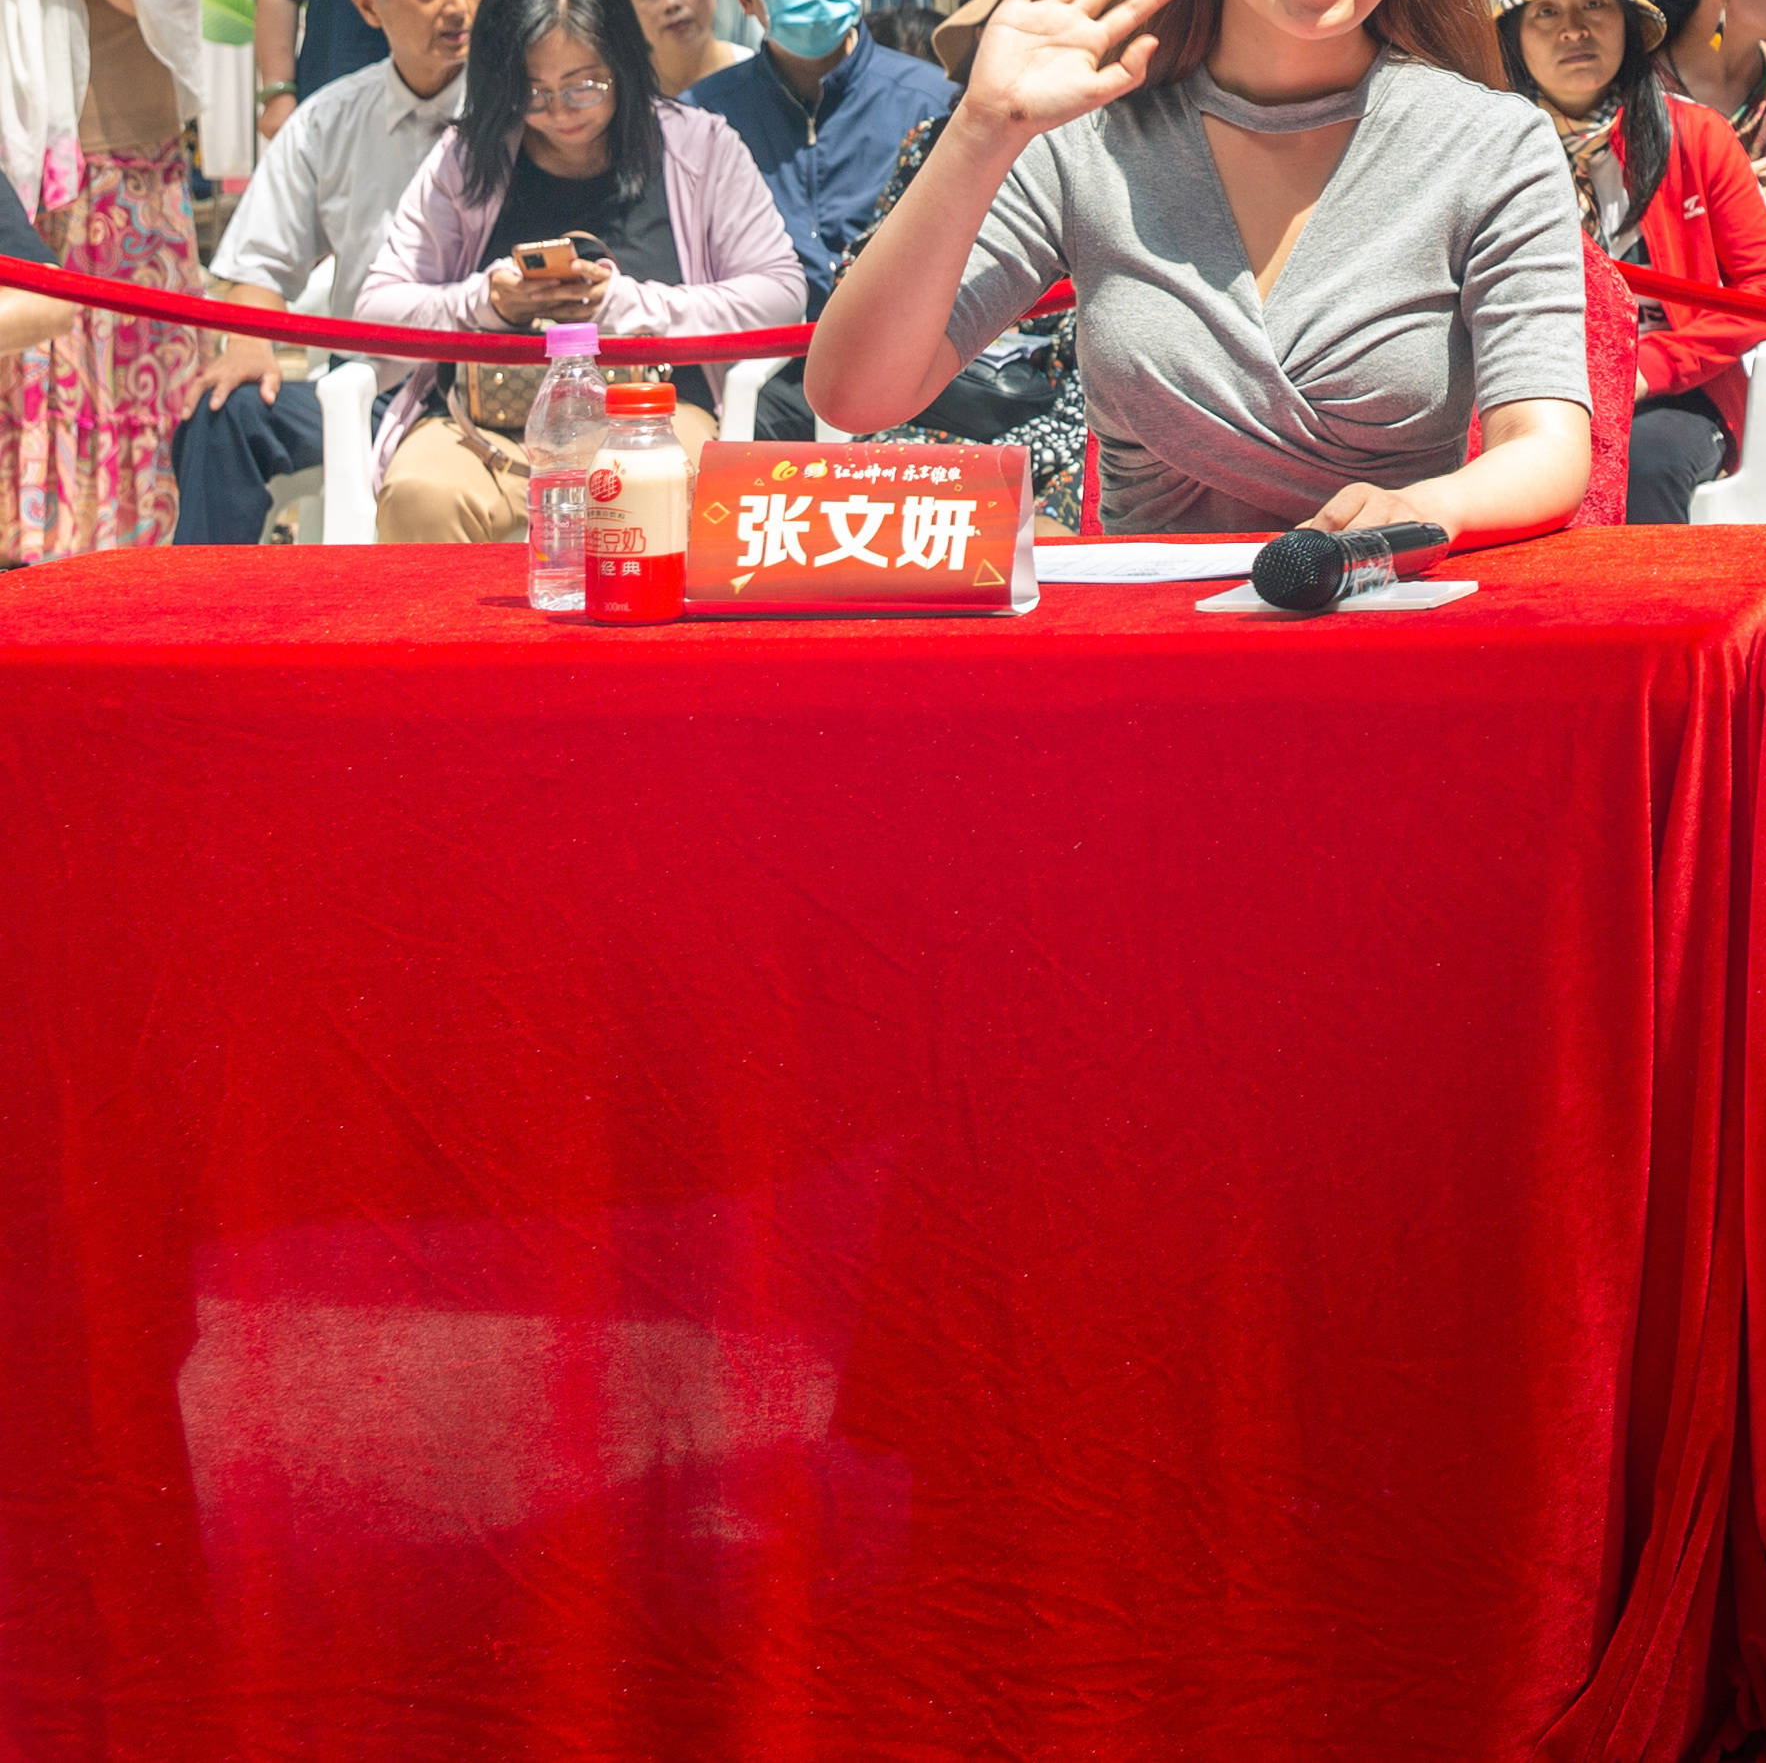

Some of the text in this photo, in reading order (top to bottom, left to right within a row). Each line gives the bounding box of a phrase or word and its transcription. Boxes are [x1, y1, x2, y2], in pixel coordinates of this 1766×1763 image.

[736, 493, 978, 571] 张文妍
[601, 560, 641, 577] 经典
